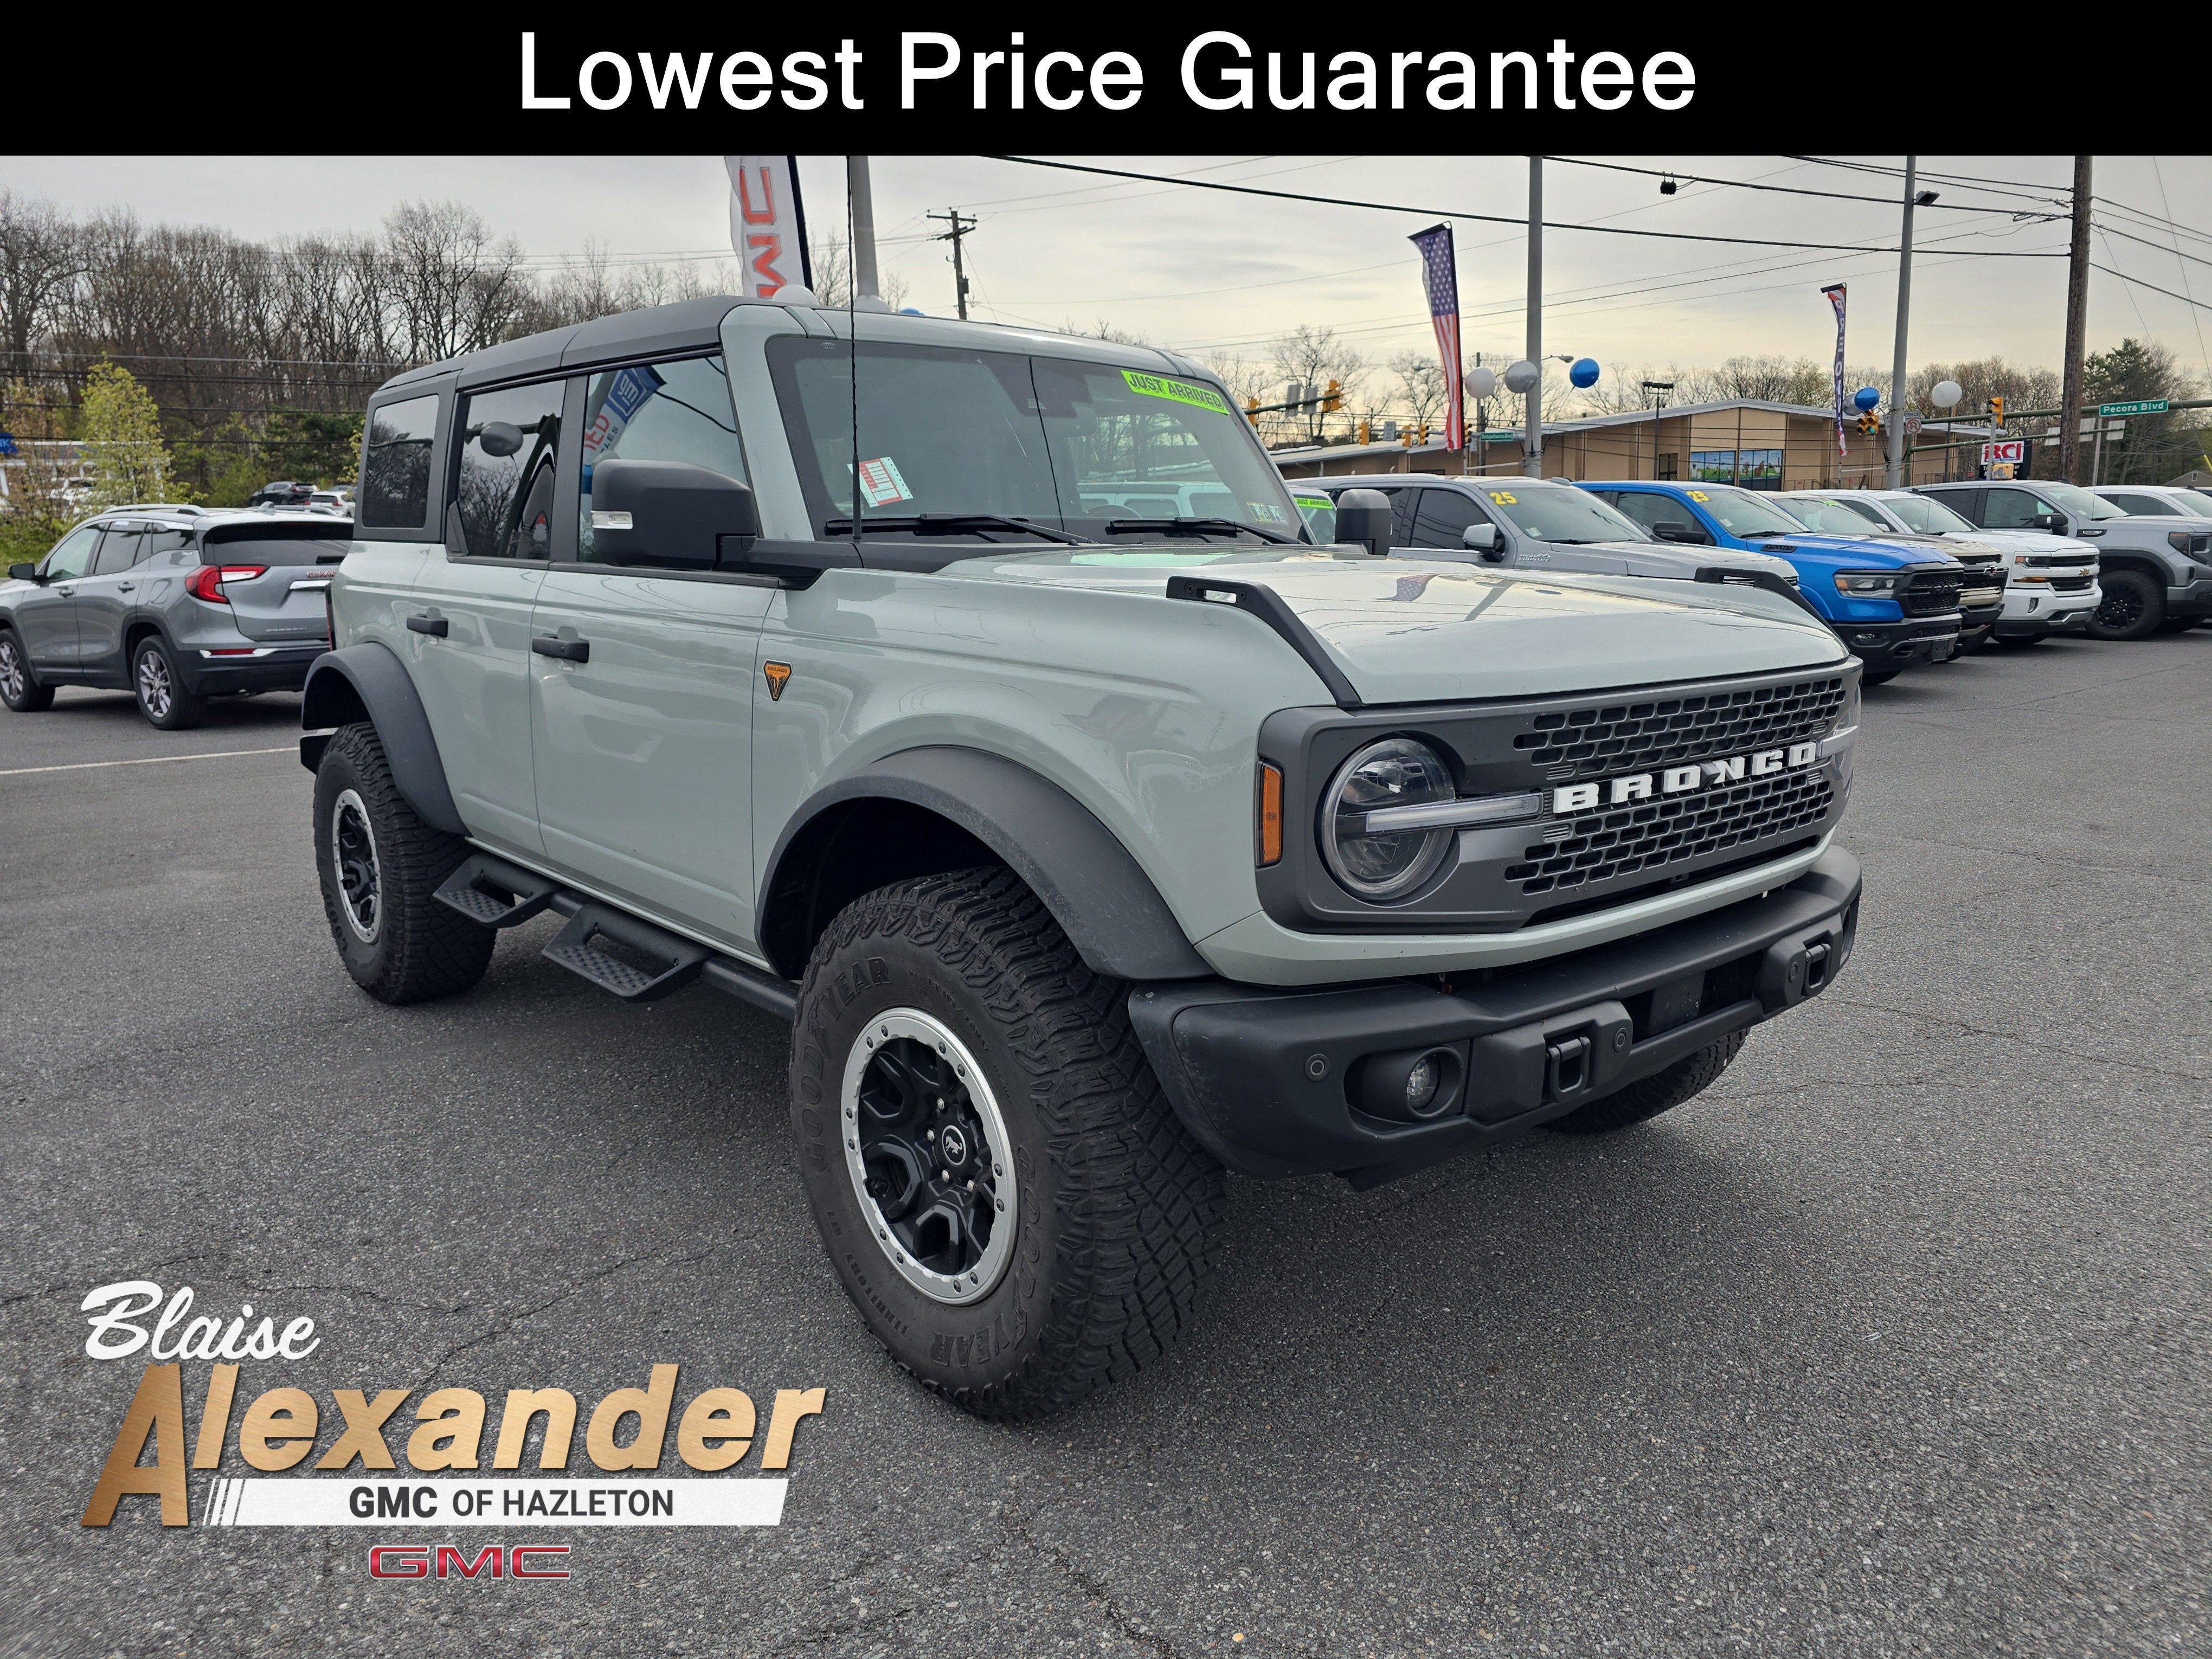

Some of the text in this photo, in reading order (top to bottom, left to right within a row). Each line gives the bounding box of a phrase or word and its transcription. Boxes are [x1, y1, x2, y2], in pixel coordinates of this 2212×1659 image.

[1129, 374, 1225, 410] JUST ARRIVED
[2104, 402, 2164, 414] Pecora Blvd
[1490, 491, 1517, 505] 25
[1686, 490, 1710, 503] 23
[1553, 741, 1817, 814] BRONCO
